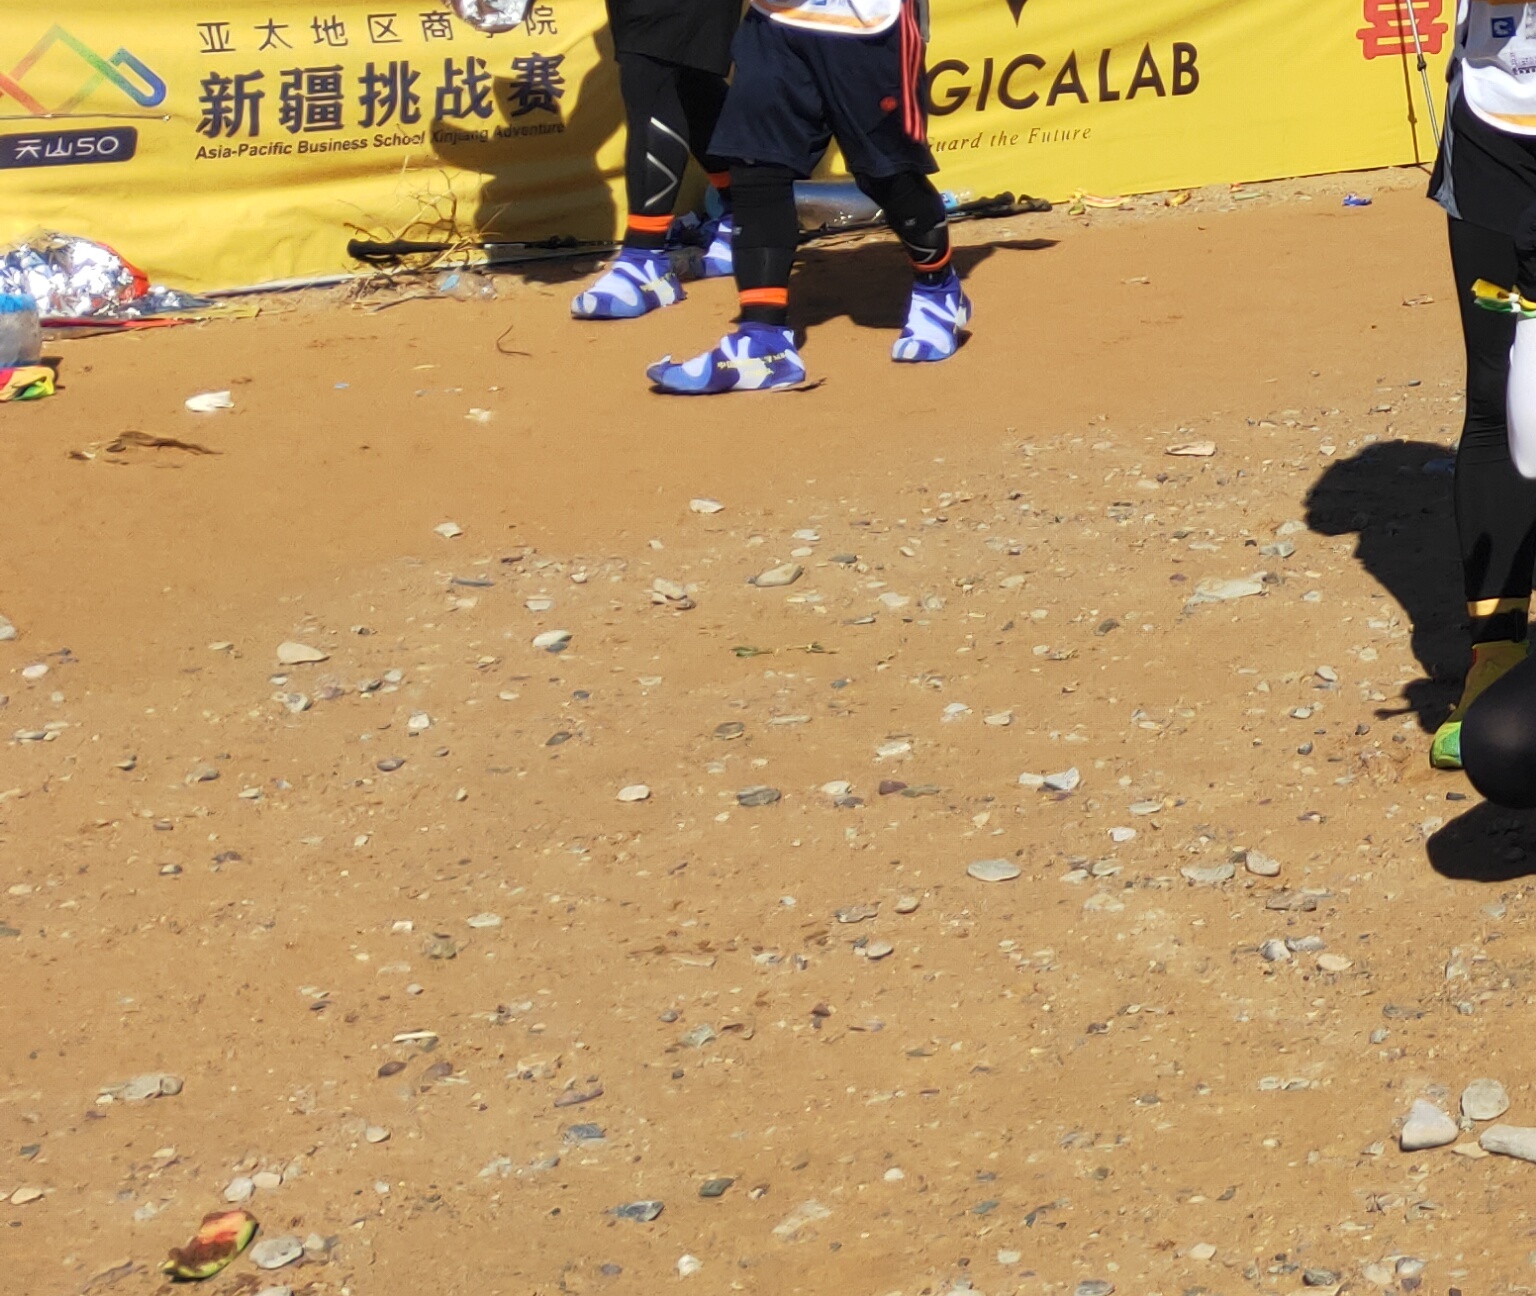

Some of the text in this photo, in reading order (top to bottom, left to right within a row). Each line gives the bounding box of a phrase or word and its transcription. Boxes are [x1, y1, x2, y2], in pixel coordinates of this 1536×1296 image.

[197, 5, 561, 54] 亚太地区商院
[196, 52, 567, 139] 新疆挑战赛
[195, 120, 565, 161] Asia-Pacific Business School Xinjiang Adventure
[990, 130, 1018, 147] the
[1028, 127, 1091, 144] Future
